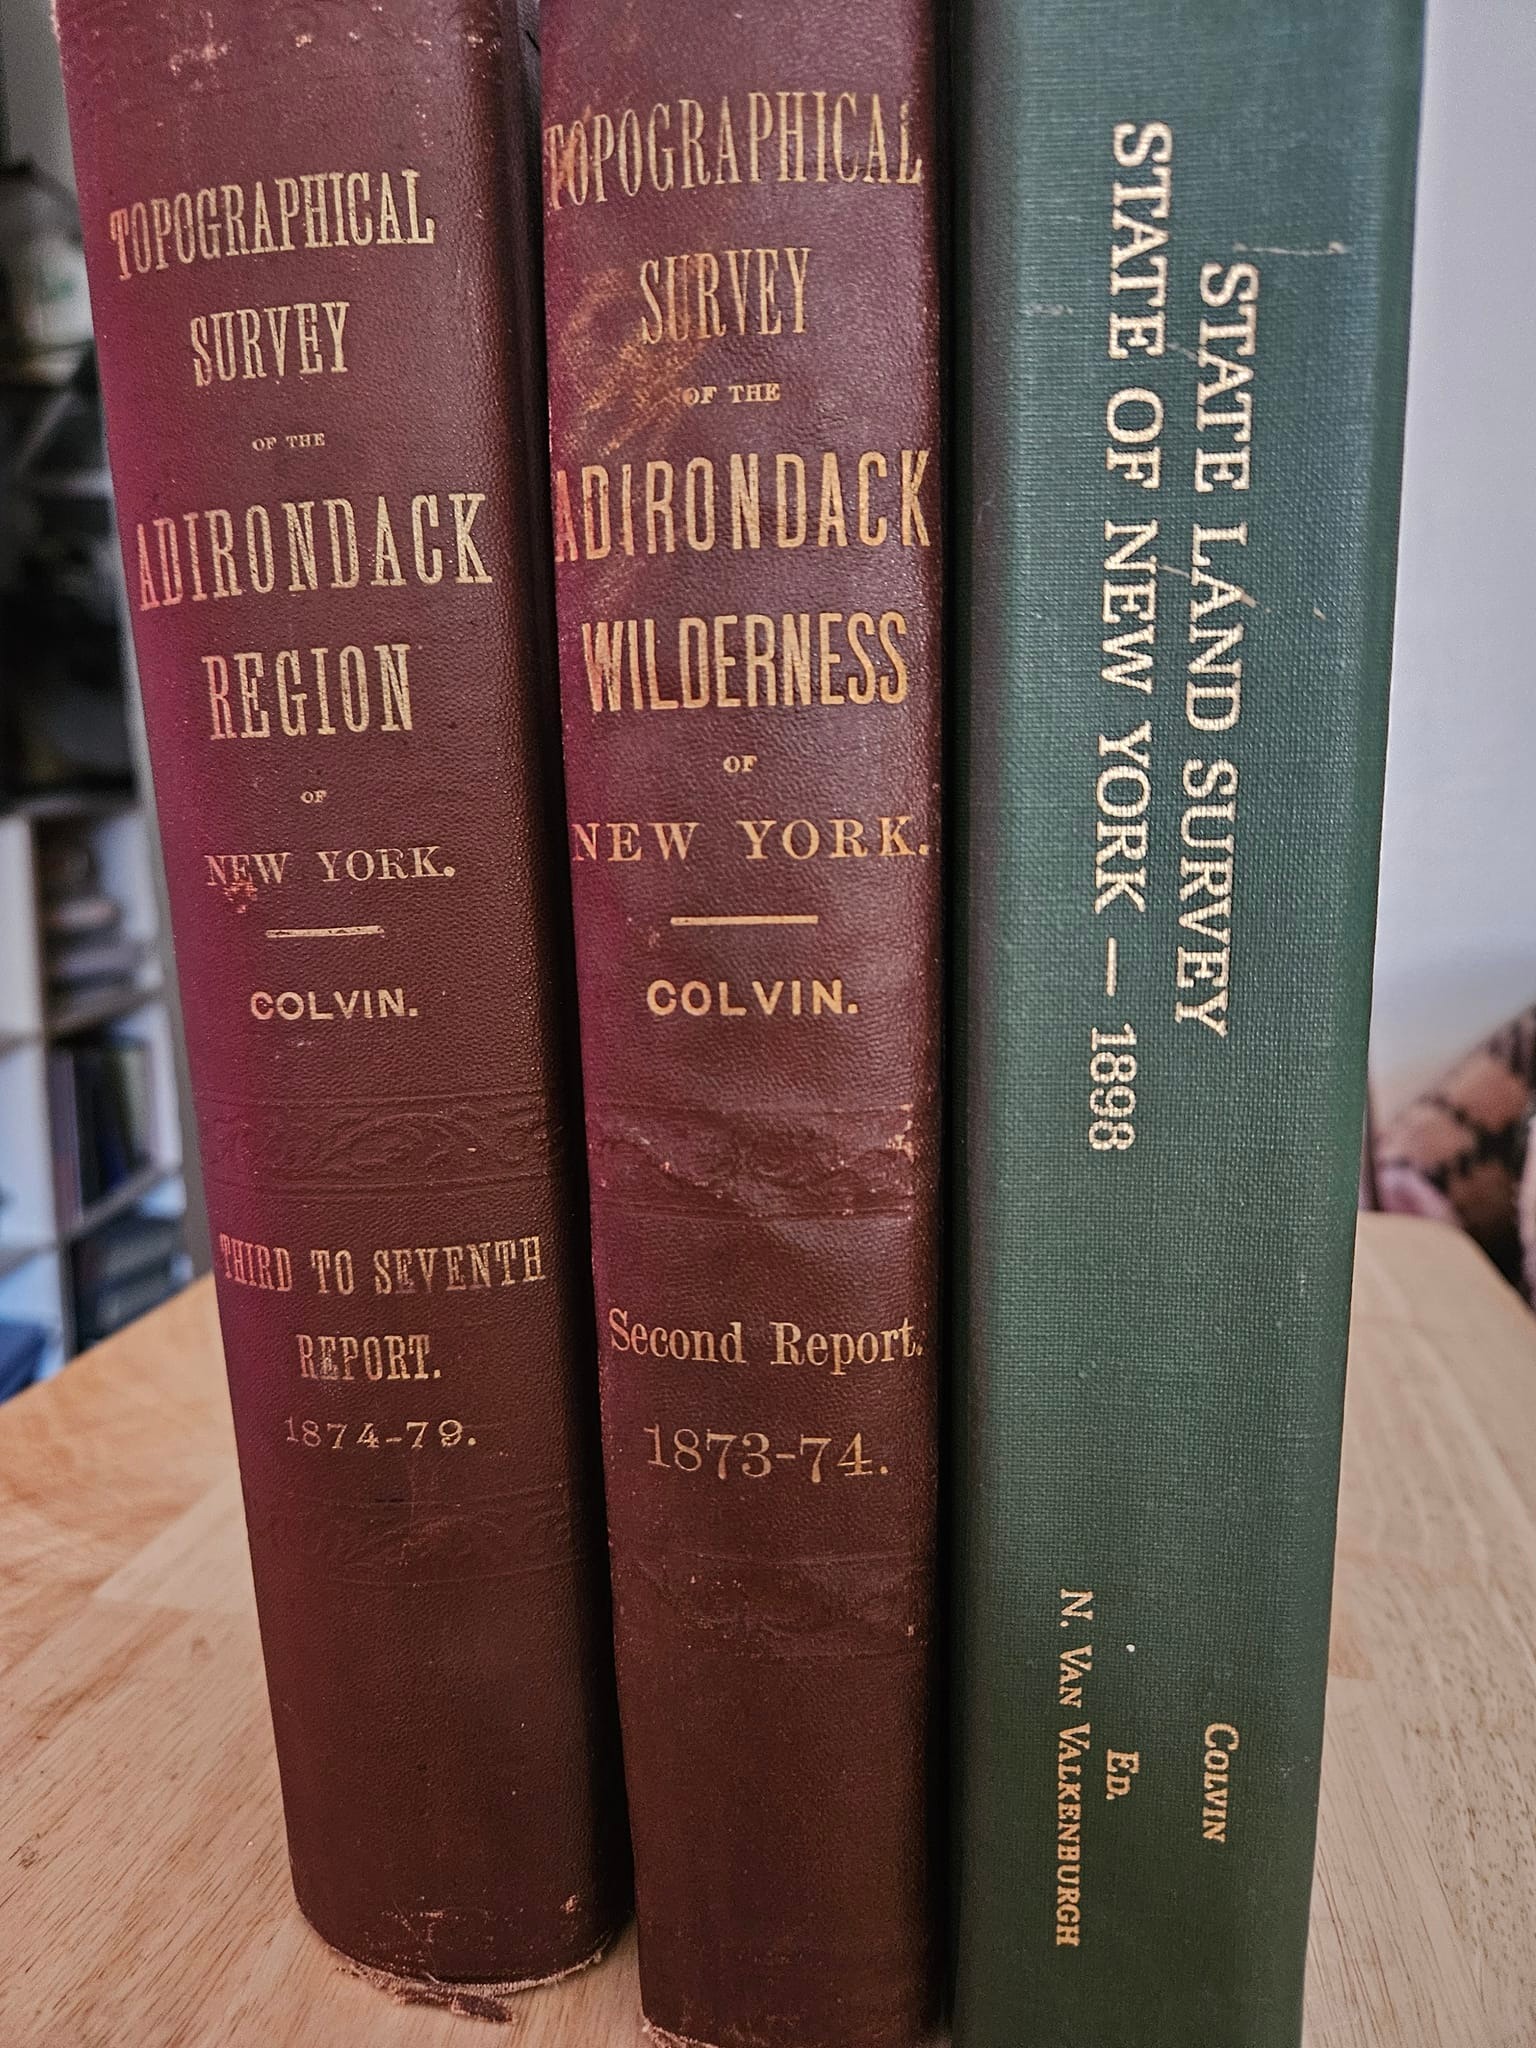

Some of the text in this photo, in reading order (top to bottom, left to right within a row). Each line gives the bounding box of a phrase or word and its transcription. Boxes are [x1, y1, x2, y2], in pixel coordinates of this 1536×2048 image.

[545, 90, 923, 212] TOPOGRAPHICAL
[109, 169, 436, 281] TOPOGRAPHICAL
[1107, 120, 1173, 360] STATE
[640, 247, 812, 346] SURVEY
[190, 301, 350, 387] SURVEY
[685, 382, 781, 405] OF THE
[252, 432, 326, 452] OF THE
[1105, 387, 1165, 490] OF
[554, 449, 931, 563] ADIRONDACK
[136, 493, 493, 611] ADIRONDACK
[1100, 518, 1159, 696] NEW
[581, 612, 909, 713] WILDERNESS
[1174, 261, 1260, 1040] STATE LAND SURVEY
[202, 643, 414, 741] REGION
[300, 790, 327, 804] OF
[722, 754, 758, 773] OF
[571, 815, 930, 864] NEW YORK.
[1094, 719, 1153, 915] YORK
[204, 845, 455, 886] NEW YORK.
[250, 987, 418, 1021] COLVIN.
[646, 978, 859, 1017] COLVIN.
[1088, 1022, 1138, 1152] 1898
[219, 1232, 546, 1295] THIRD TO SEVENTH
[296, 1333, 441, 1382] REPORT.
[608, 1308, 924, 1376] Second Report.
[286, 1415, 477, 1450] 1874-79.
[643, 1423, 890, 1485] 1873-74.
[1060, 1588, 1094, 1628] N.
